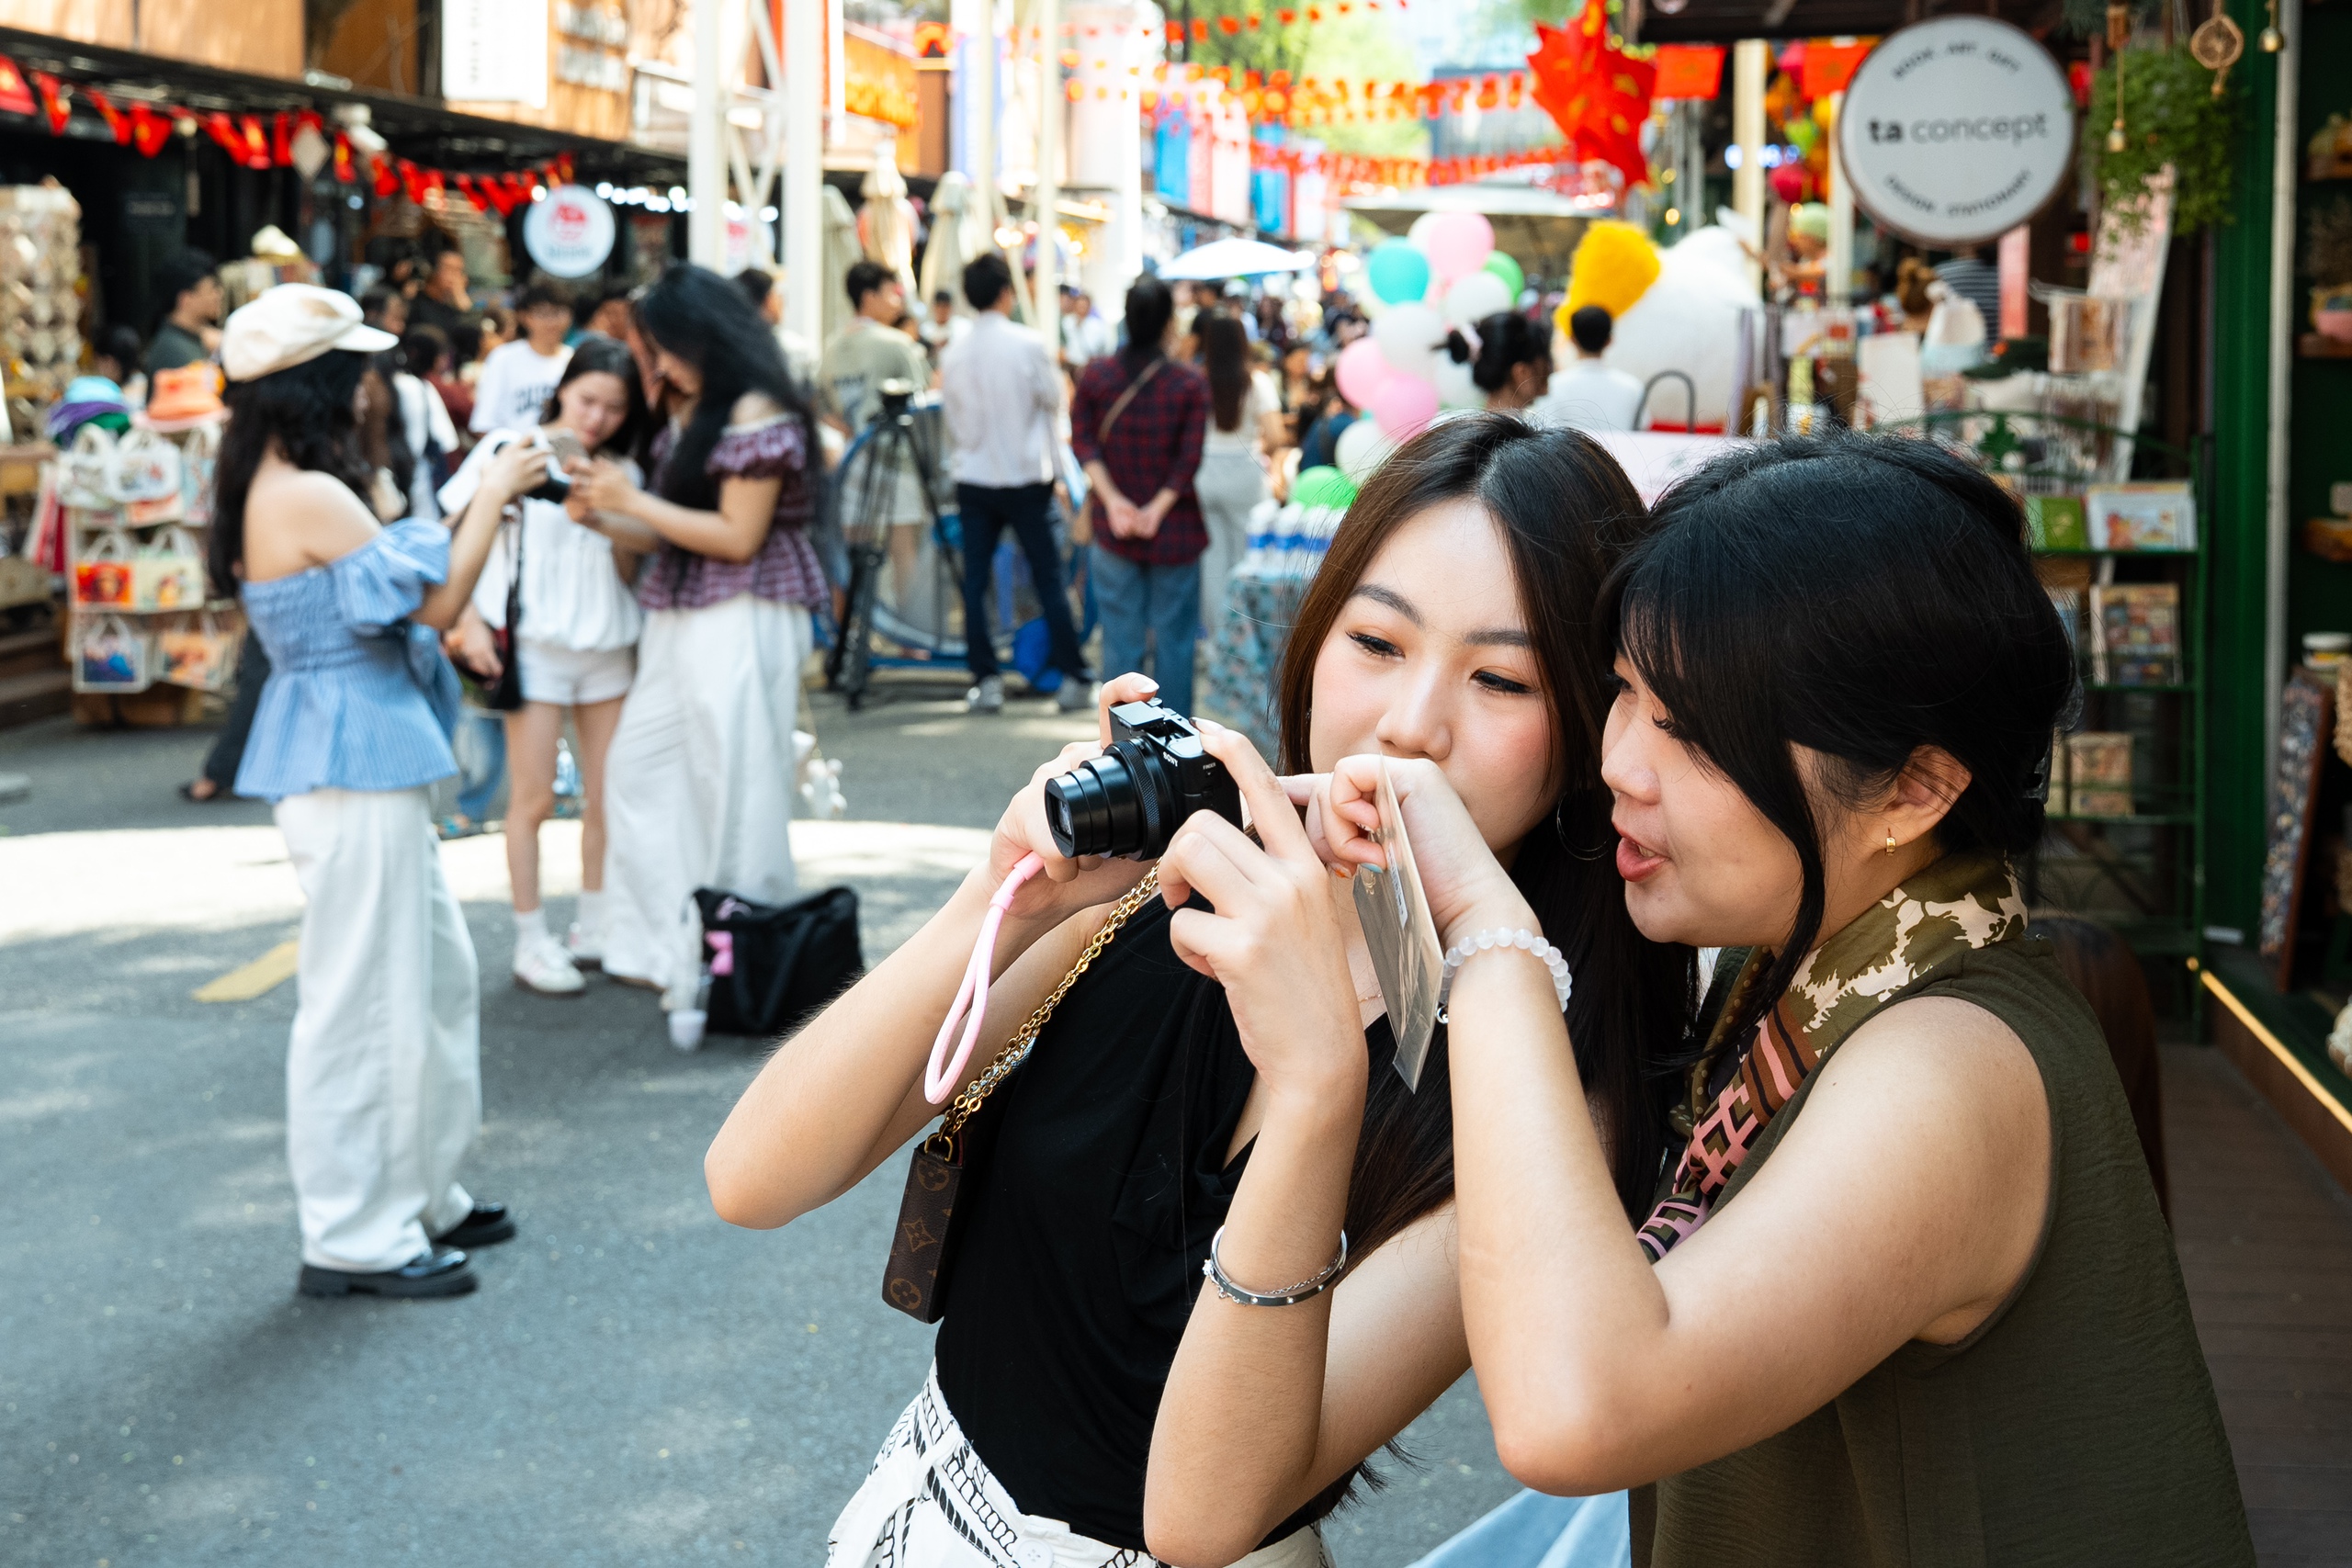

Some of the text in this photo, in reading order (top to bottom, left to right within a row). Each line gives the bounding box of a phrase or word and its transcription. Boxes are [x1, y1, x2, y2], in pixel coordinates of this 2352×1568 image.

[1892, 47, 1936, 80] BOOK
[1946, 41, 1978, 56] ART
[1869, 112, 2048, 147] ta concept
[1886, 175, 1936, 214] DESIGN
[1162, 751, 1178, 767] SONY
